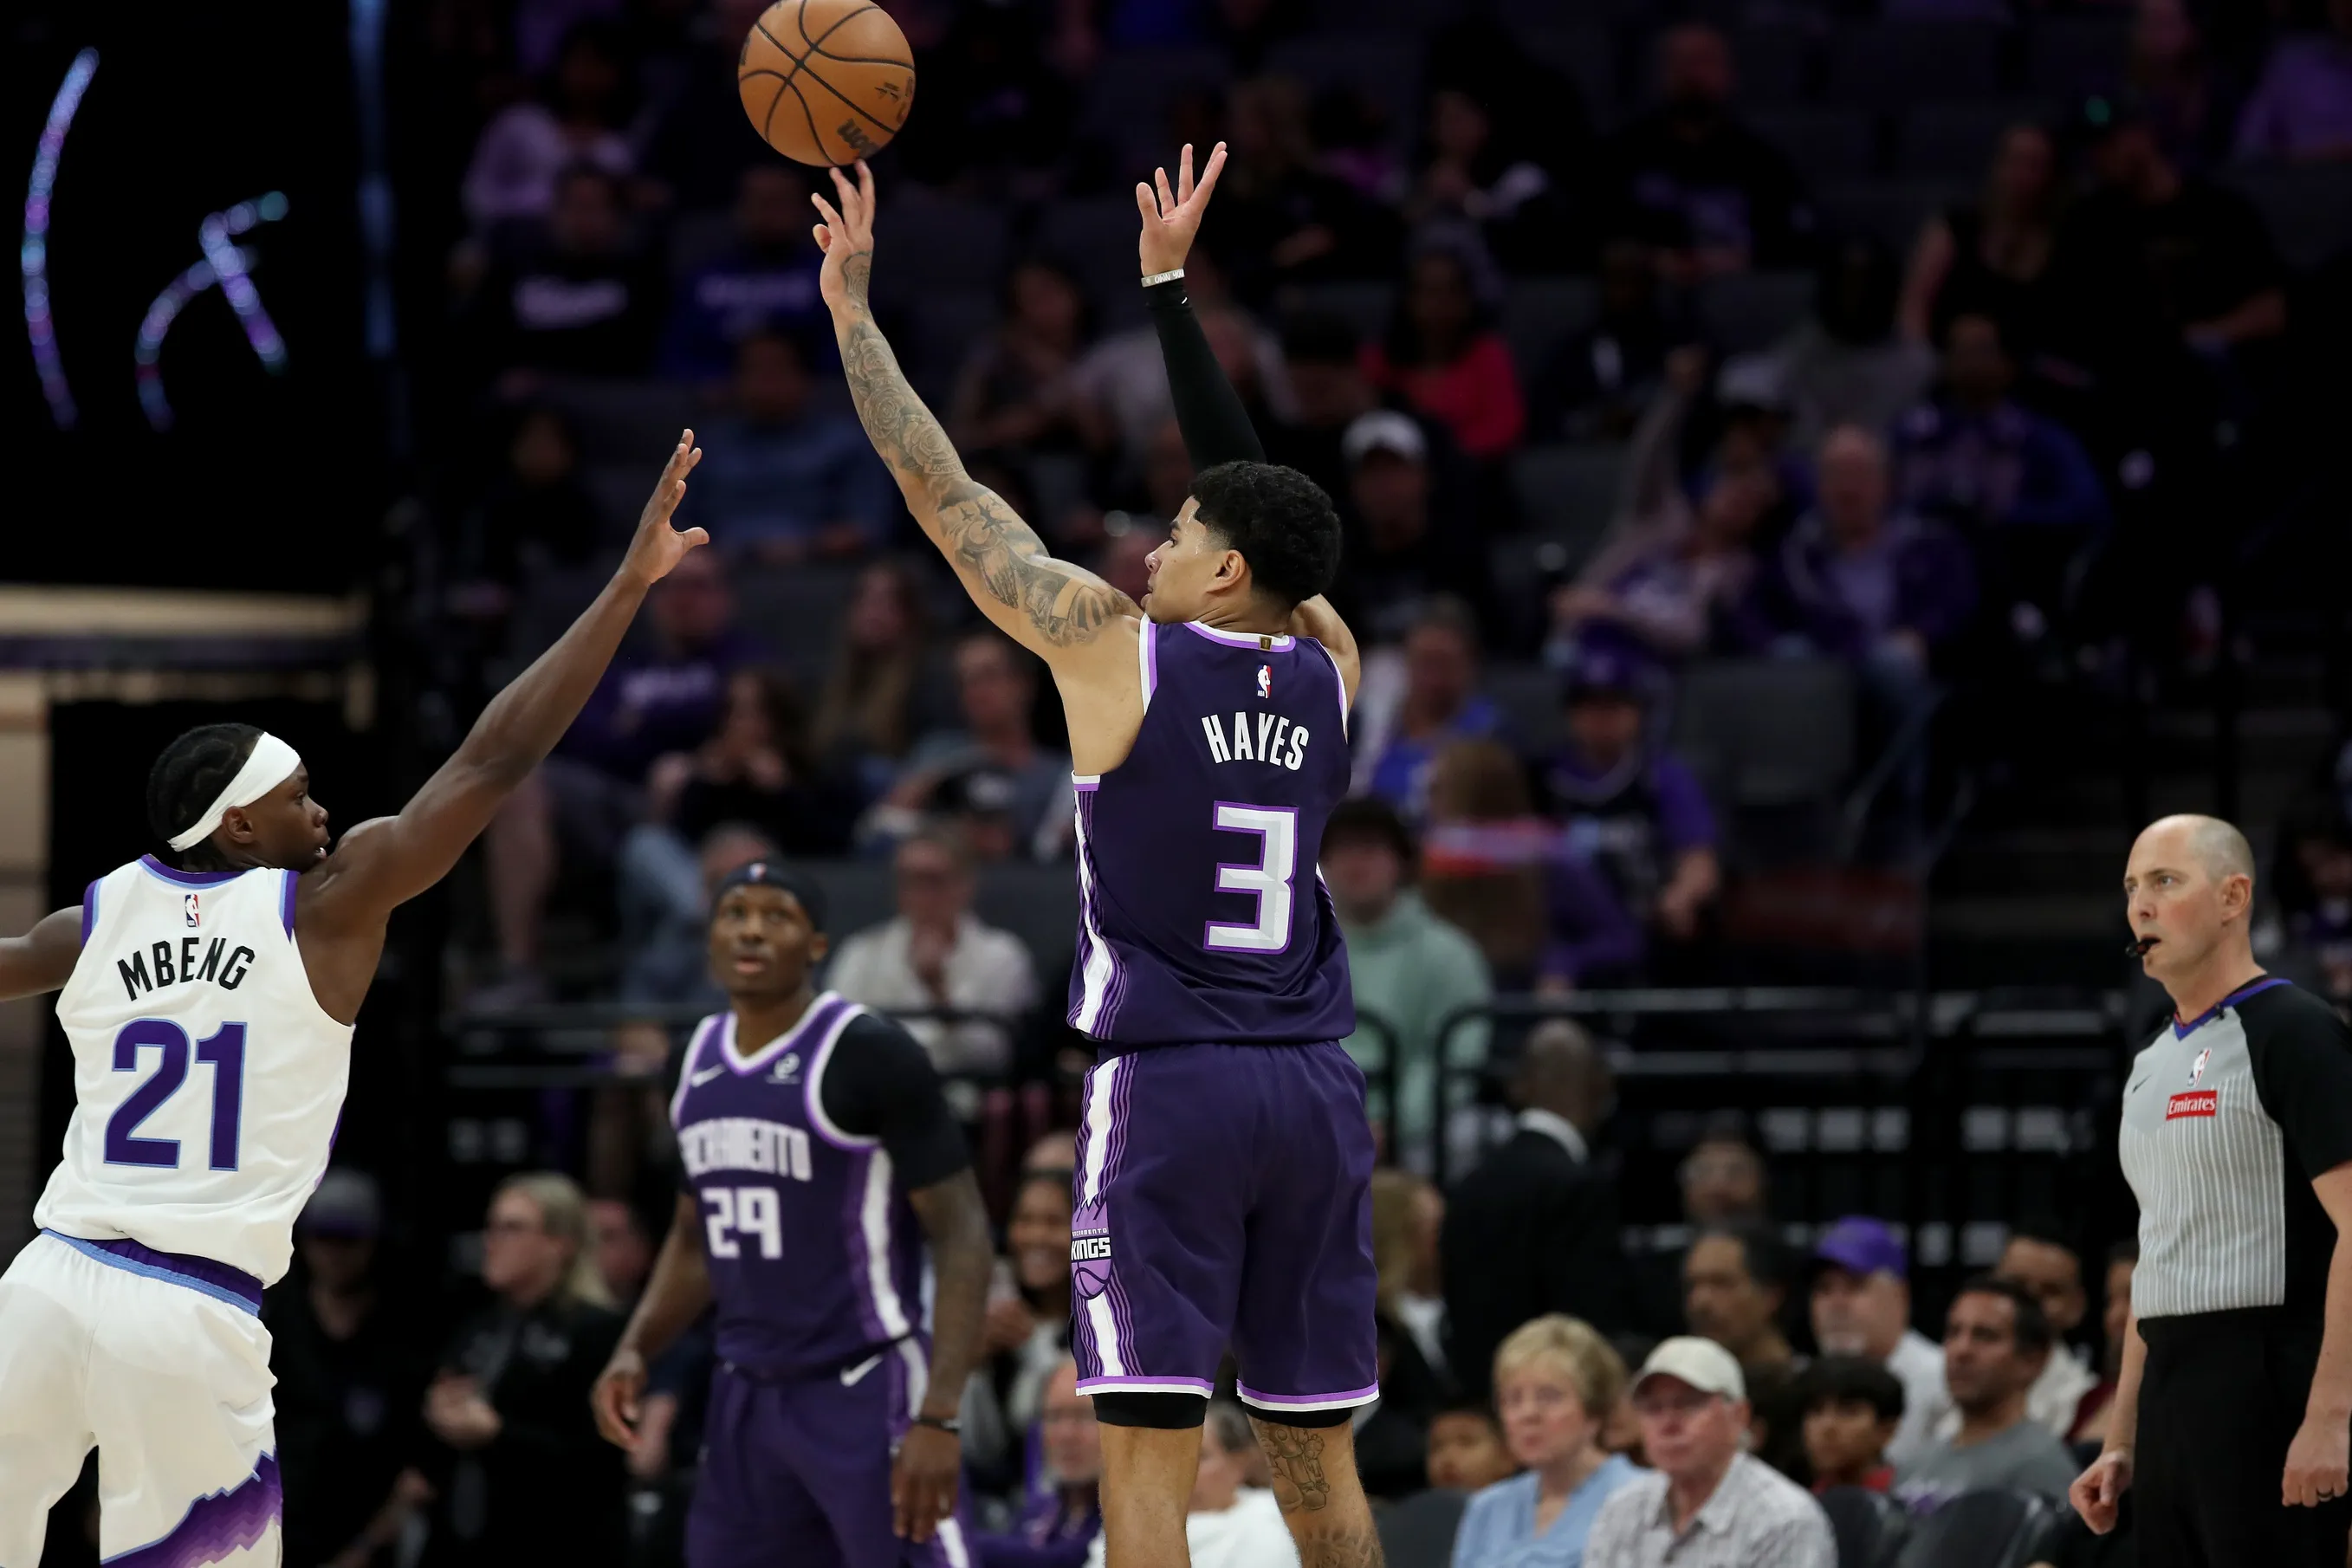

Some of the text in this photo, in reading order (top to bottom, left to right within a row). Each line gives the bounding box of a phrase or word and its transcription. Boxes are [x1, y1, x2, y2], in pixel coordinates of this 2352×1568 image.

[1201, 711, 1310, 771] HAYES
[1203, 800, 1299, 955] 3
[117, 936, 255, 1001] MBENG
[103, 1017, 248, 1172] 21
[2168, 1096, 2215, 1115] Emirates
[701, 1186, 782, 1259] 29
[1071, 1236, 1111, 1260] KINGS
